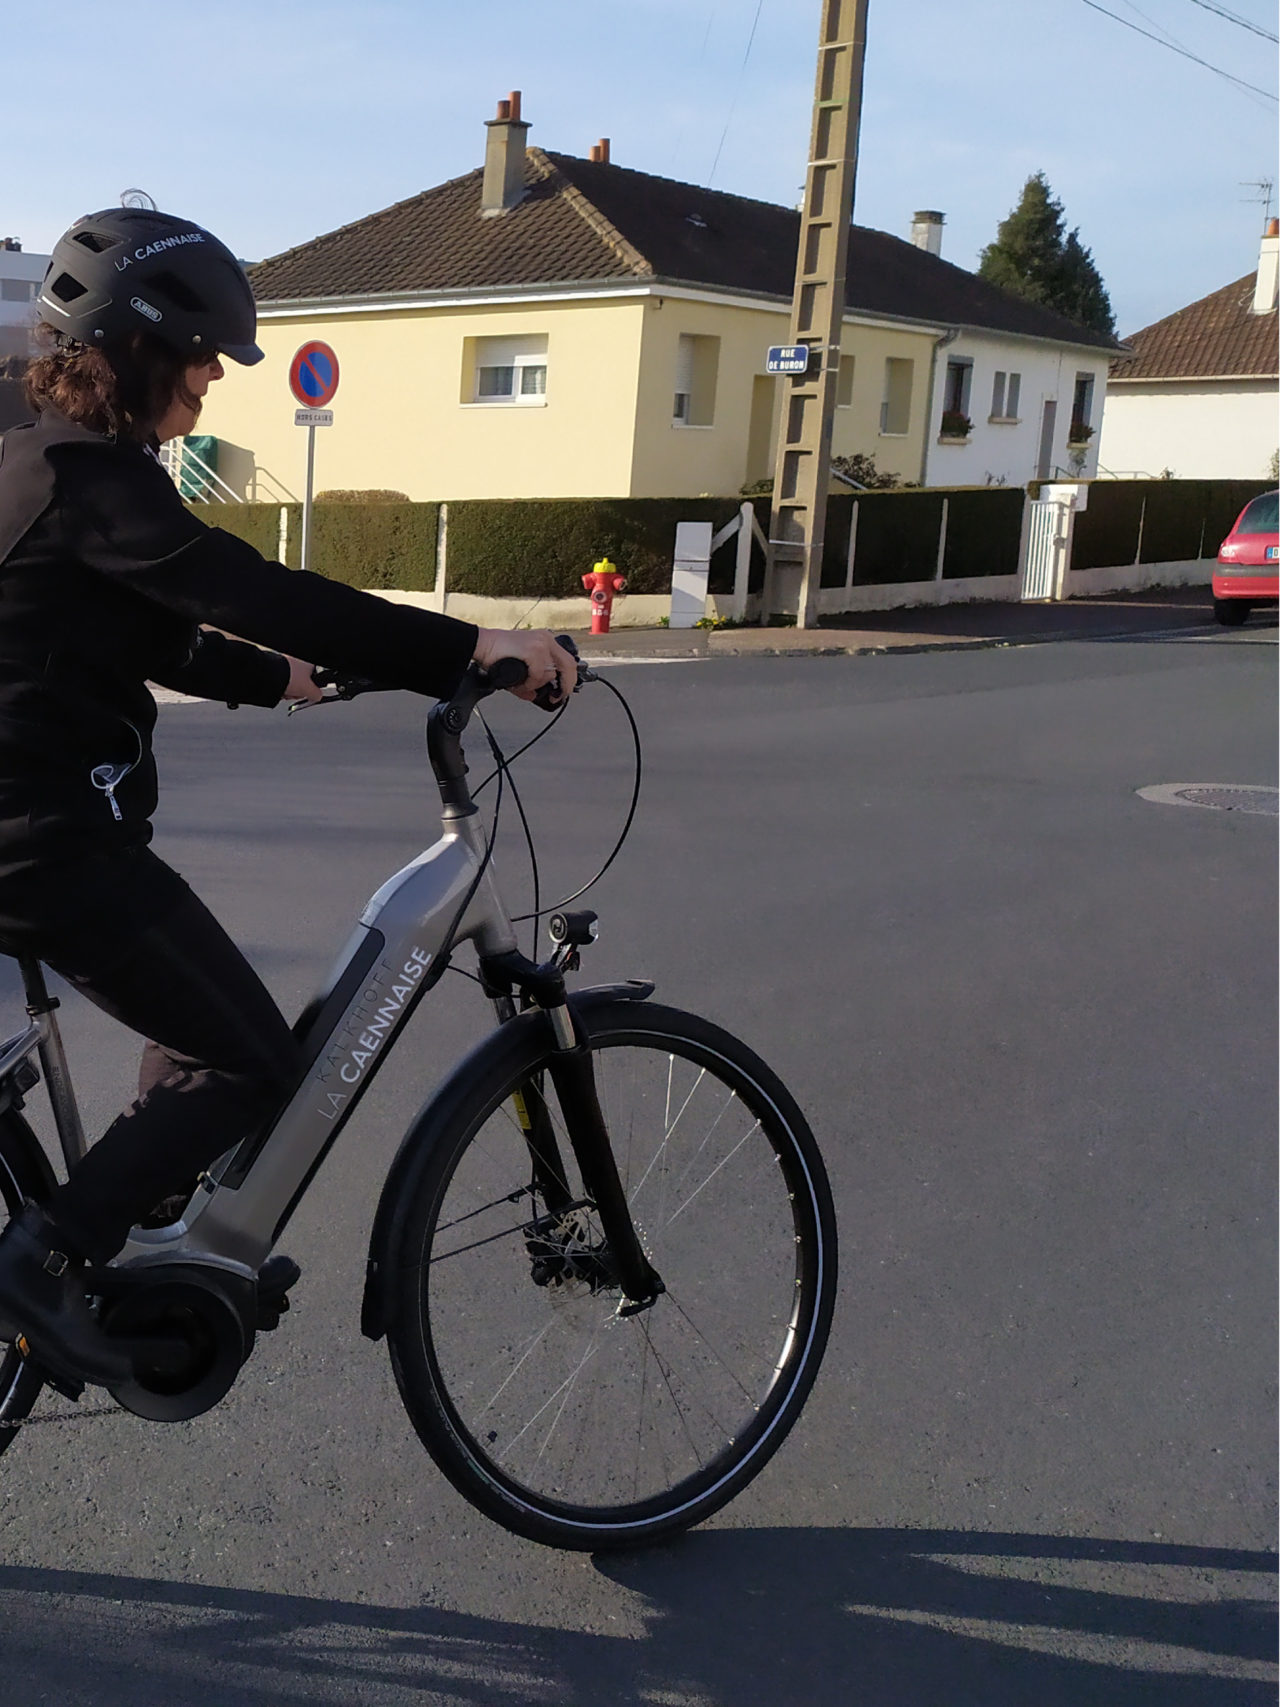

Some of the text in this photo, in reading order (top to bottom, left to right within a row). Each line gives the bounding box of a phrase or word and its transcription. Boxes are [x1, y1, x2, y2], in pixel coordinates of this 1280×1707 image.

[114, 233, 205, 272] LA CAENNAISE
[134, 299, 160, 319] ABUS
[780, 348, 796, 358] RUE
[769, 360, 779, 370] DE
[317, 946, 433, 1120] LA CAENNAISE
